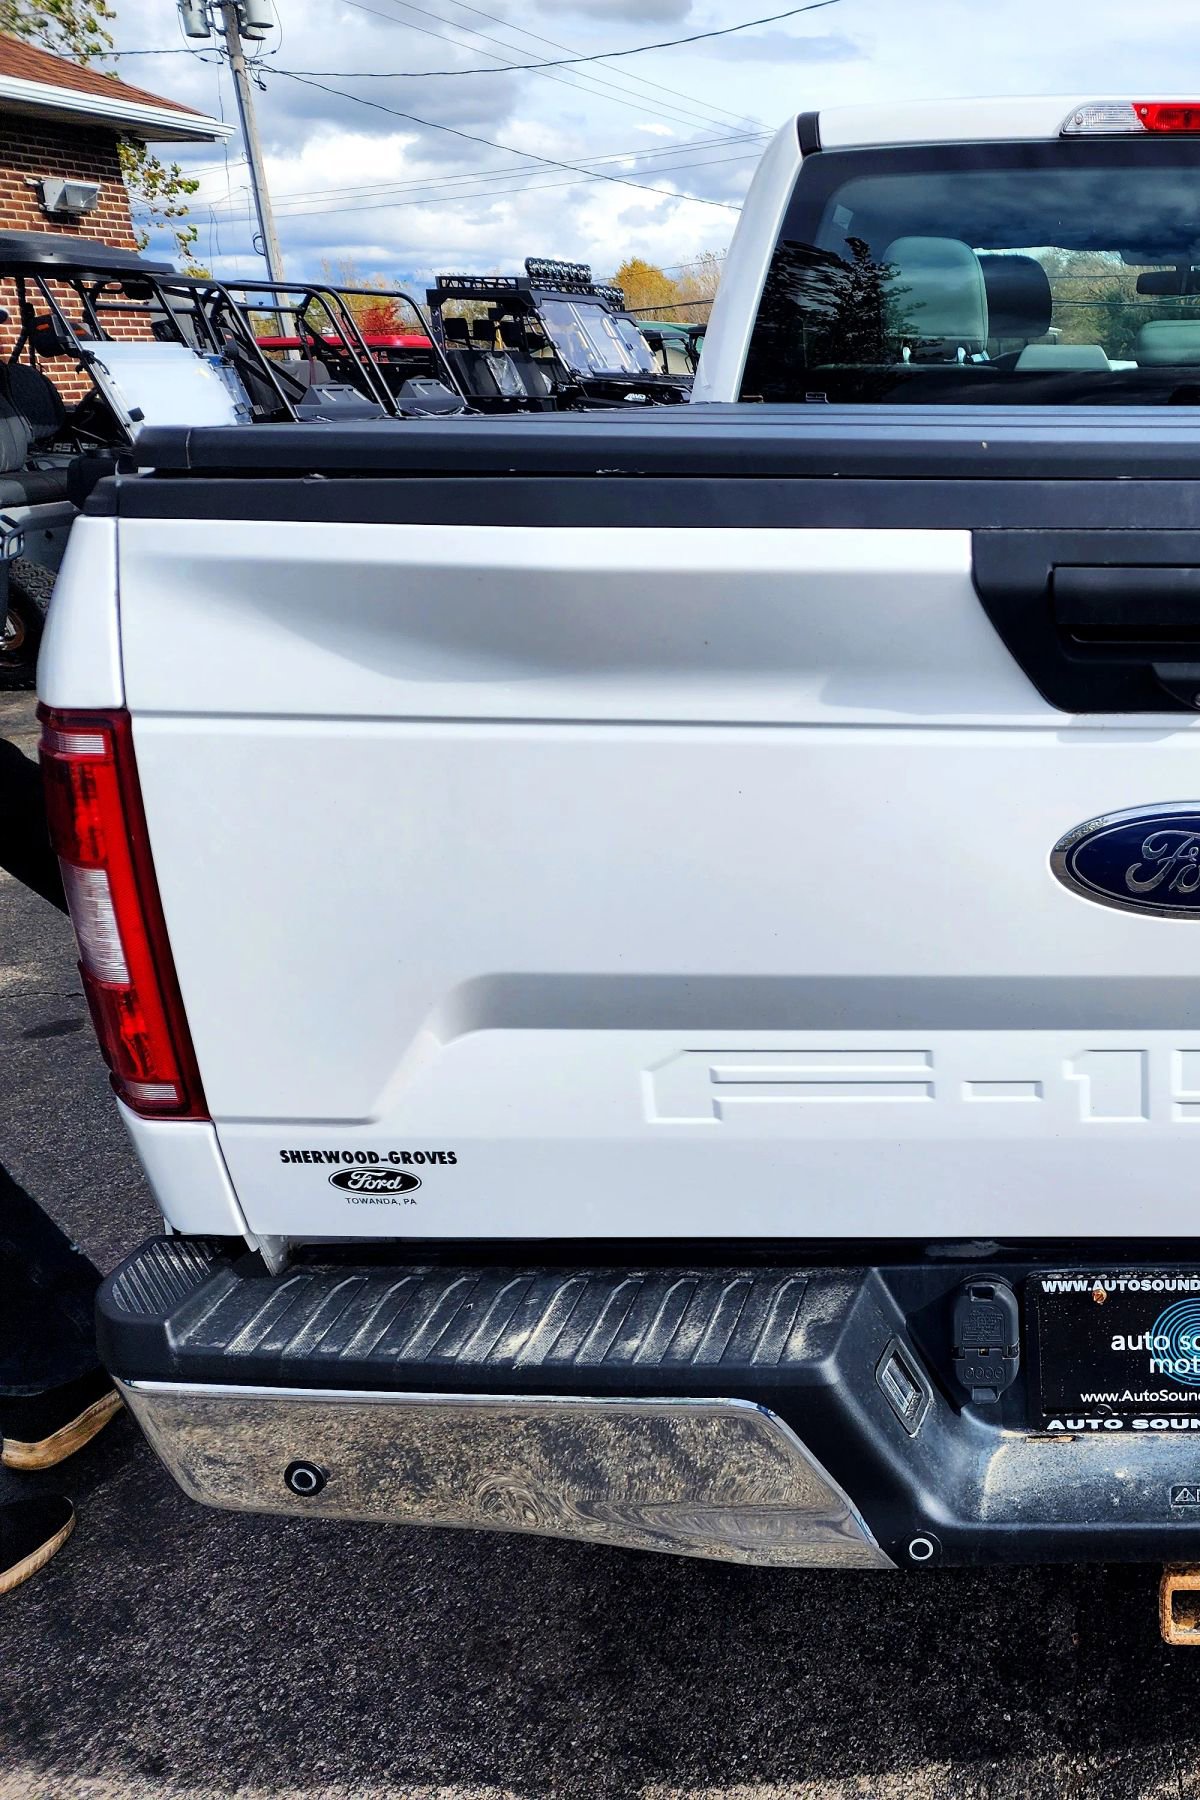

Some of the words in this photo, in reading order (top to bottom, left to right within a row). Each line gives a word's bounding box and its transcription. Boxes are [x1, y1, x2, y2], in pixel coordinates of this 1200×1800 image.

[279, 1149, 458, 1165] SHERWOOD-GROVES
[347, 1170, 403, 1190] Ford
[345, 1197, 400, 1205] TOWANDA,
[1110, 1332, 1170, 1351] auto
[1046, 1418, 1124, 1430] AUTO
